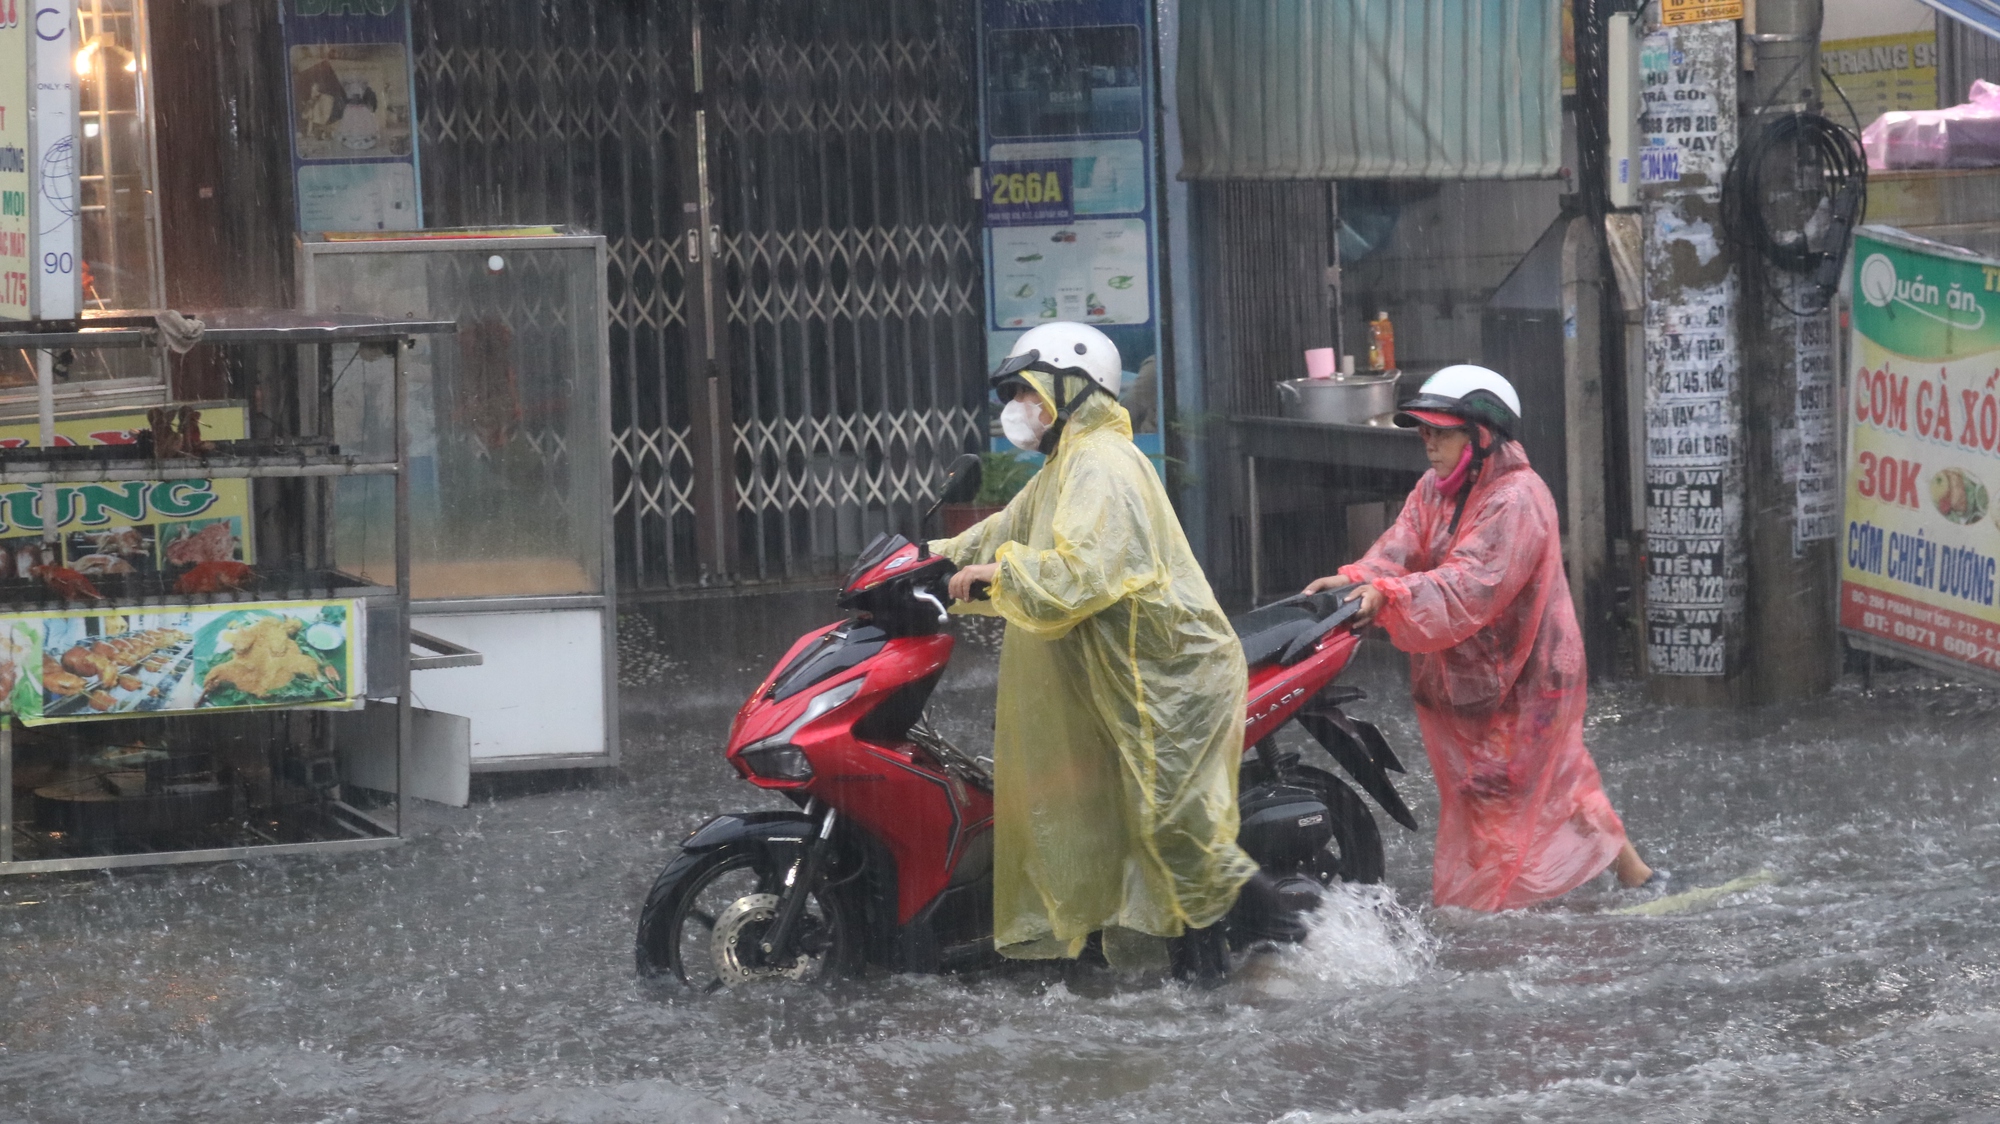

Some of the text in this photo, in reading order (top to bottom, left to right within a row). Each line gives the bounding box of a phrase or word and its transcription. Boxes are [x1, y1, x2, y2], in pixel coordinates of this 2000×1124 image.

[36, 8, 71, 41] C
[1666, 117, 1692, 133] 279
[1696, 115, 1718, 132] 216
[992, 171, 1064, 204] 266A
[43, 252, 73, 275] 90
[1861, 253, 1976, 312] Quán ăn
[1855, 361, 2000, 455] CƠM GÀ XỐ
[1683, 471, 1720, 485] VAY
[1858, 451, 1923, 509] 30K
[1684, 540, 1720, 554] VAY
[1848, 520, 1996, 606] CƠM CHIÊN DƯƠNG
[1683, 609, 1720, 624] VAY
